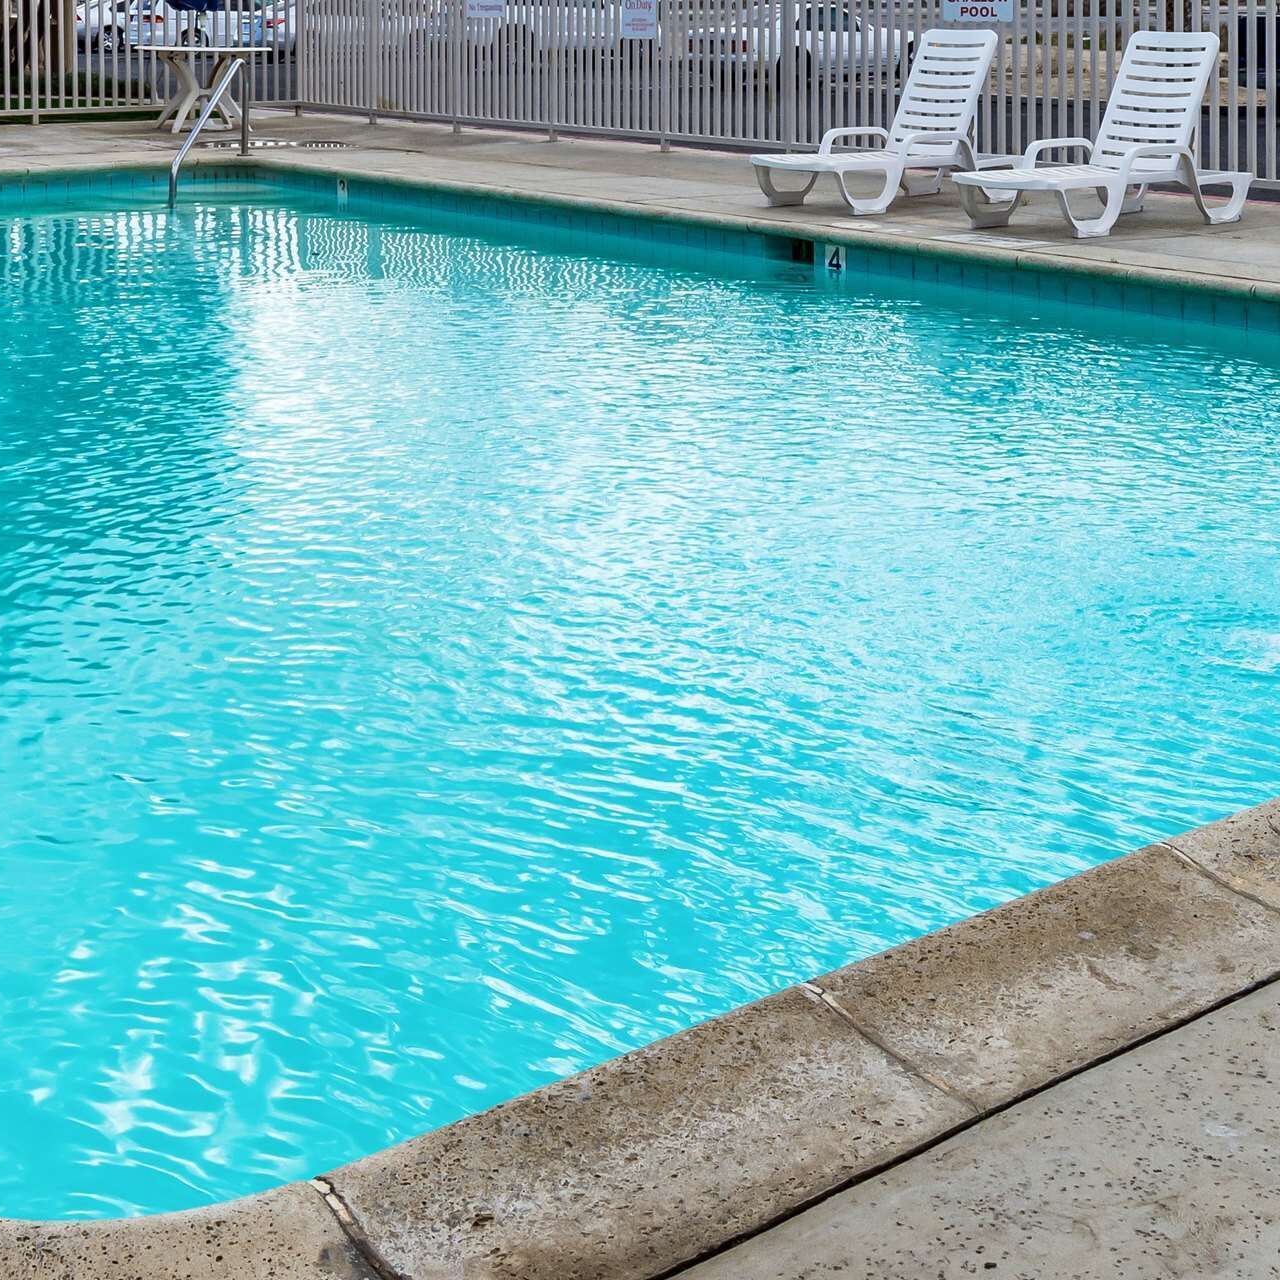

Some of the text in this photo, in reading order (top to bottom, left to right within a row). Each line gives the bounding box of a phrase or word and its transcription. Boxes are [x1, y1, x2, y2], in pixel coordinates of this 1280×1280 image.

[625, 0, 652, 12] On Duty
[960, 6, 998, 18] POOL
[828, 246, 842, 270] 4
